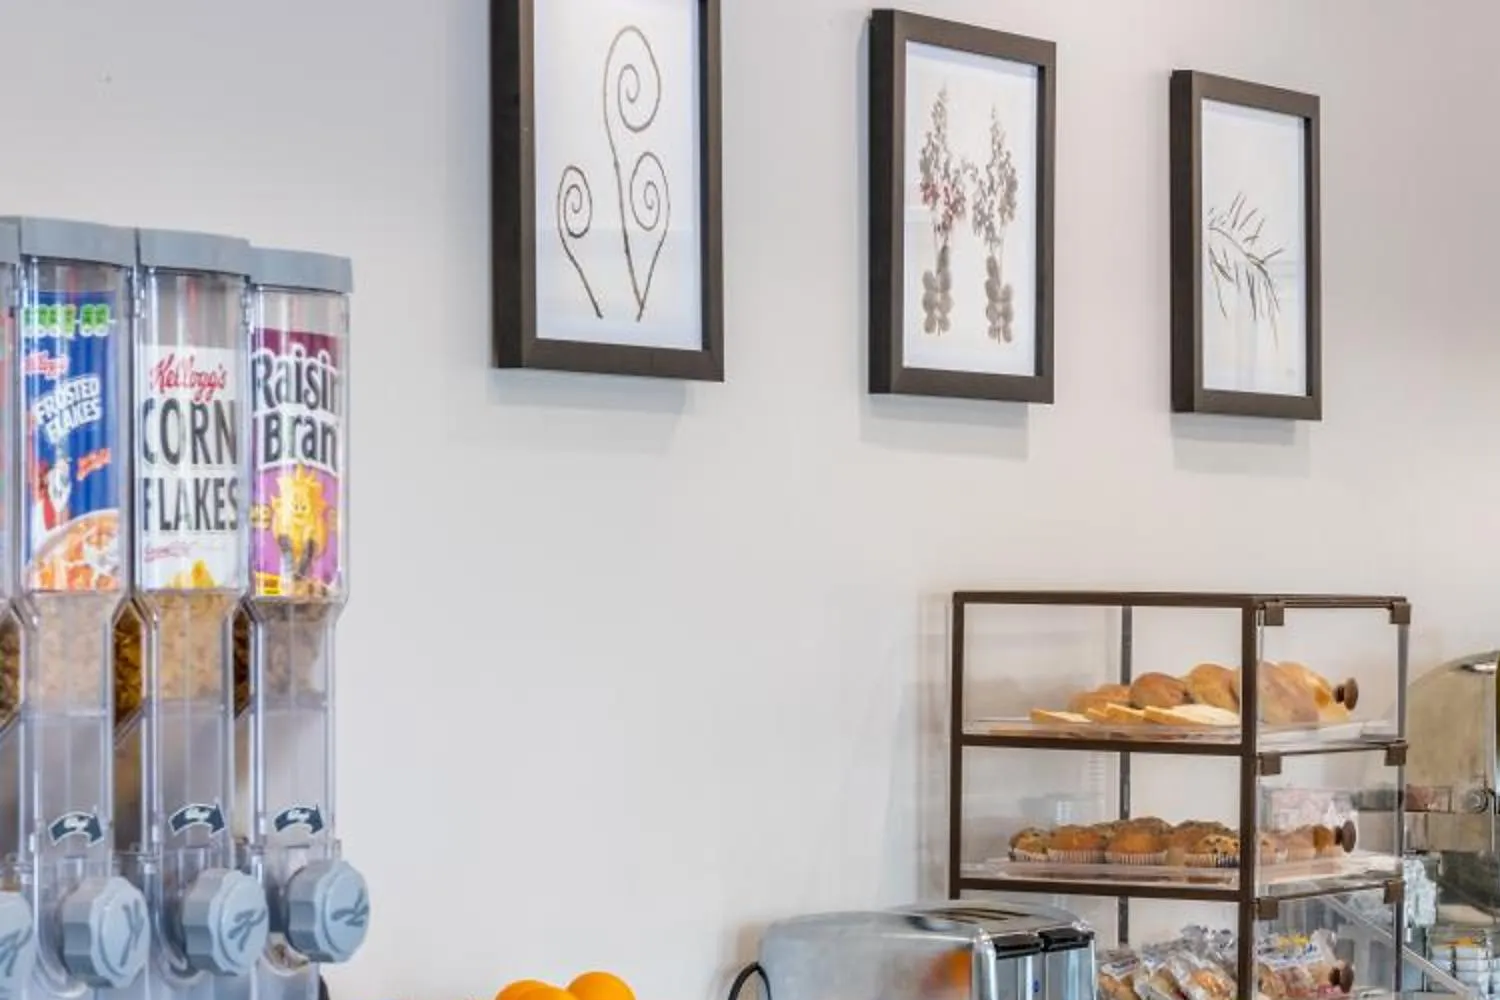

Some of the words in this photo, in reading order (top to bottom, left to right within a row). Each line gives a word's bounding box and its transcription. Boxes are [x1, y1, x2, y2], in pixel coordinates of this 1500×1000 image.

[151, 354, 227, 402] Kellogg's
[143, 398, 238, 465] CORN
[264, 412, 338, 472] Bran
[143, 477, 239, 531] FLAKES
